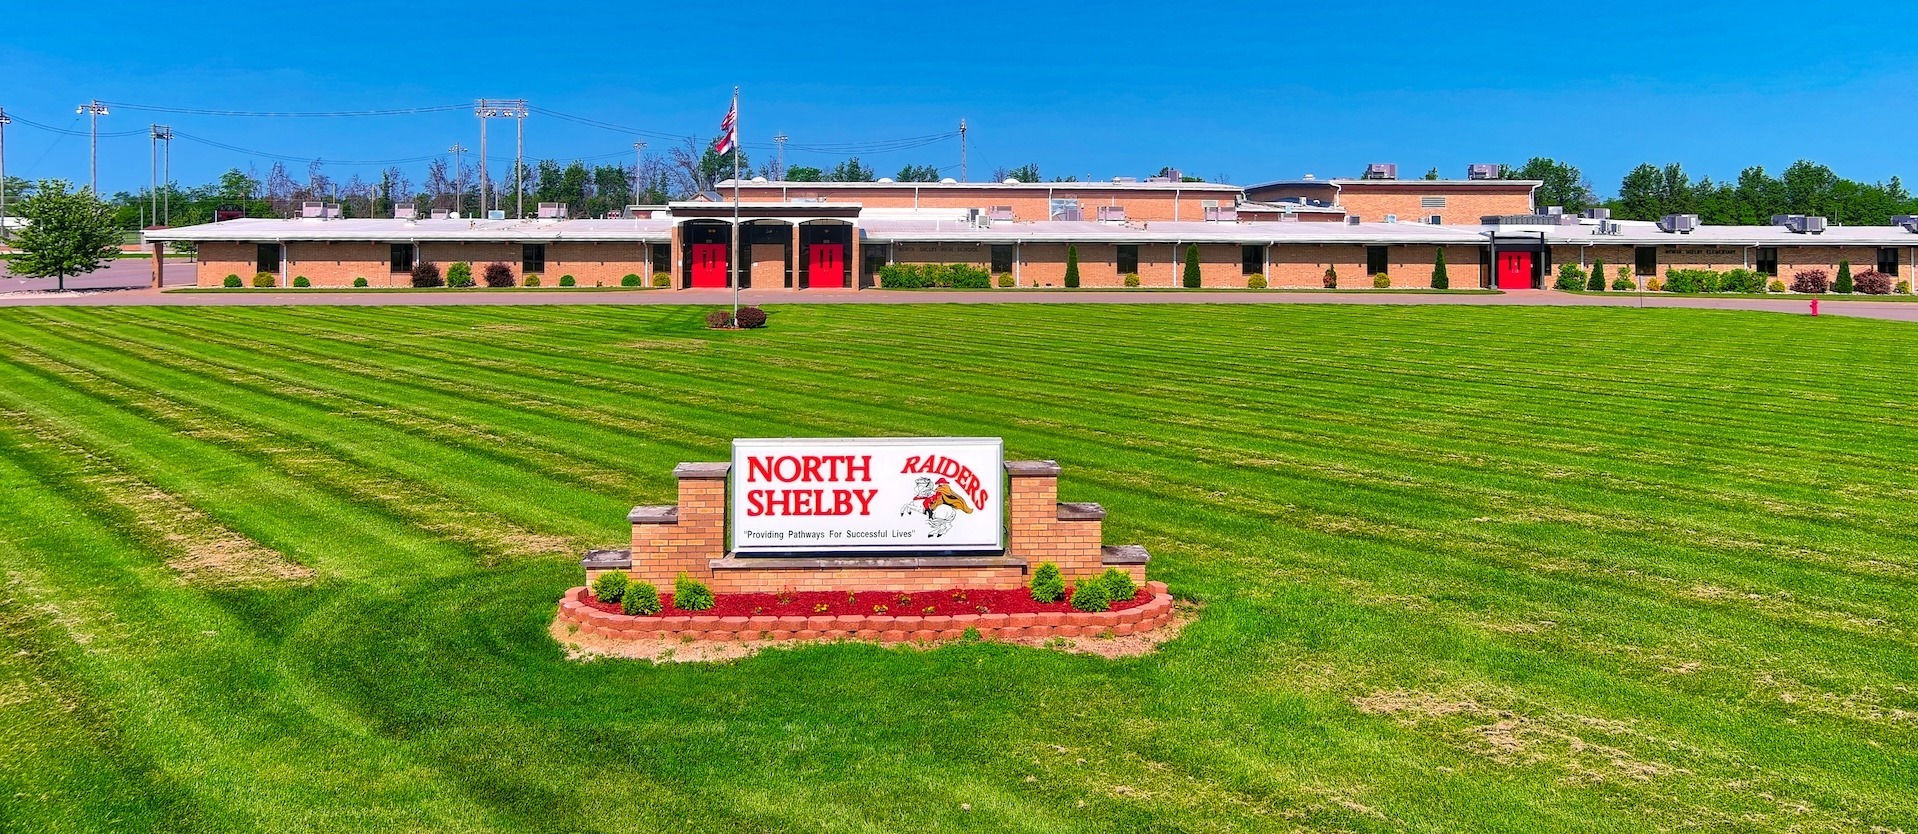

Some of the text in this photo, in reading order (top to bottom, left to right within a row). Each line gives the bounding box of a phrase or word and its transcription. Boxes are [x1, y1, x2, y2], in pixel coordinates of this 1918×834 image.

[747, 455, 872, 483] NORTH
[900, 454, 989, 511] RAIDERS
[747, 489, 879, 517] SHELBY
[744, 529, 916, 540] "Providing Pathways For Successful Lives"
